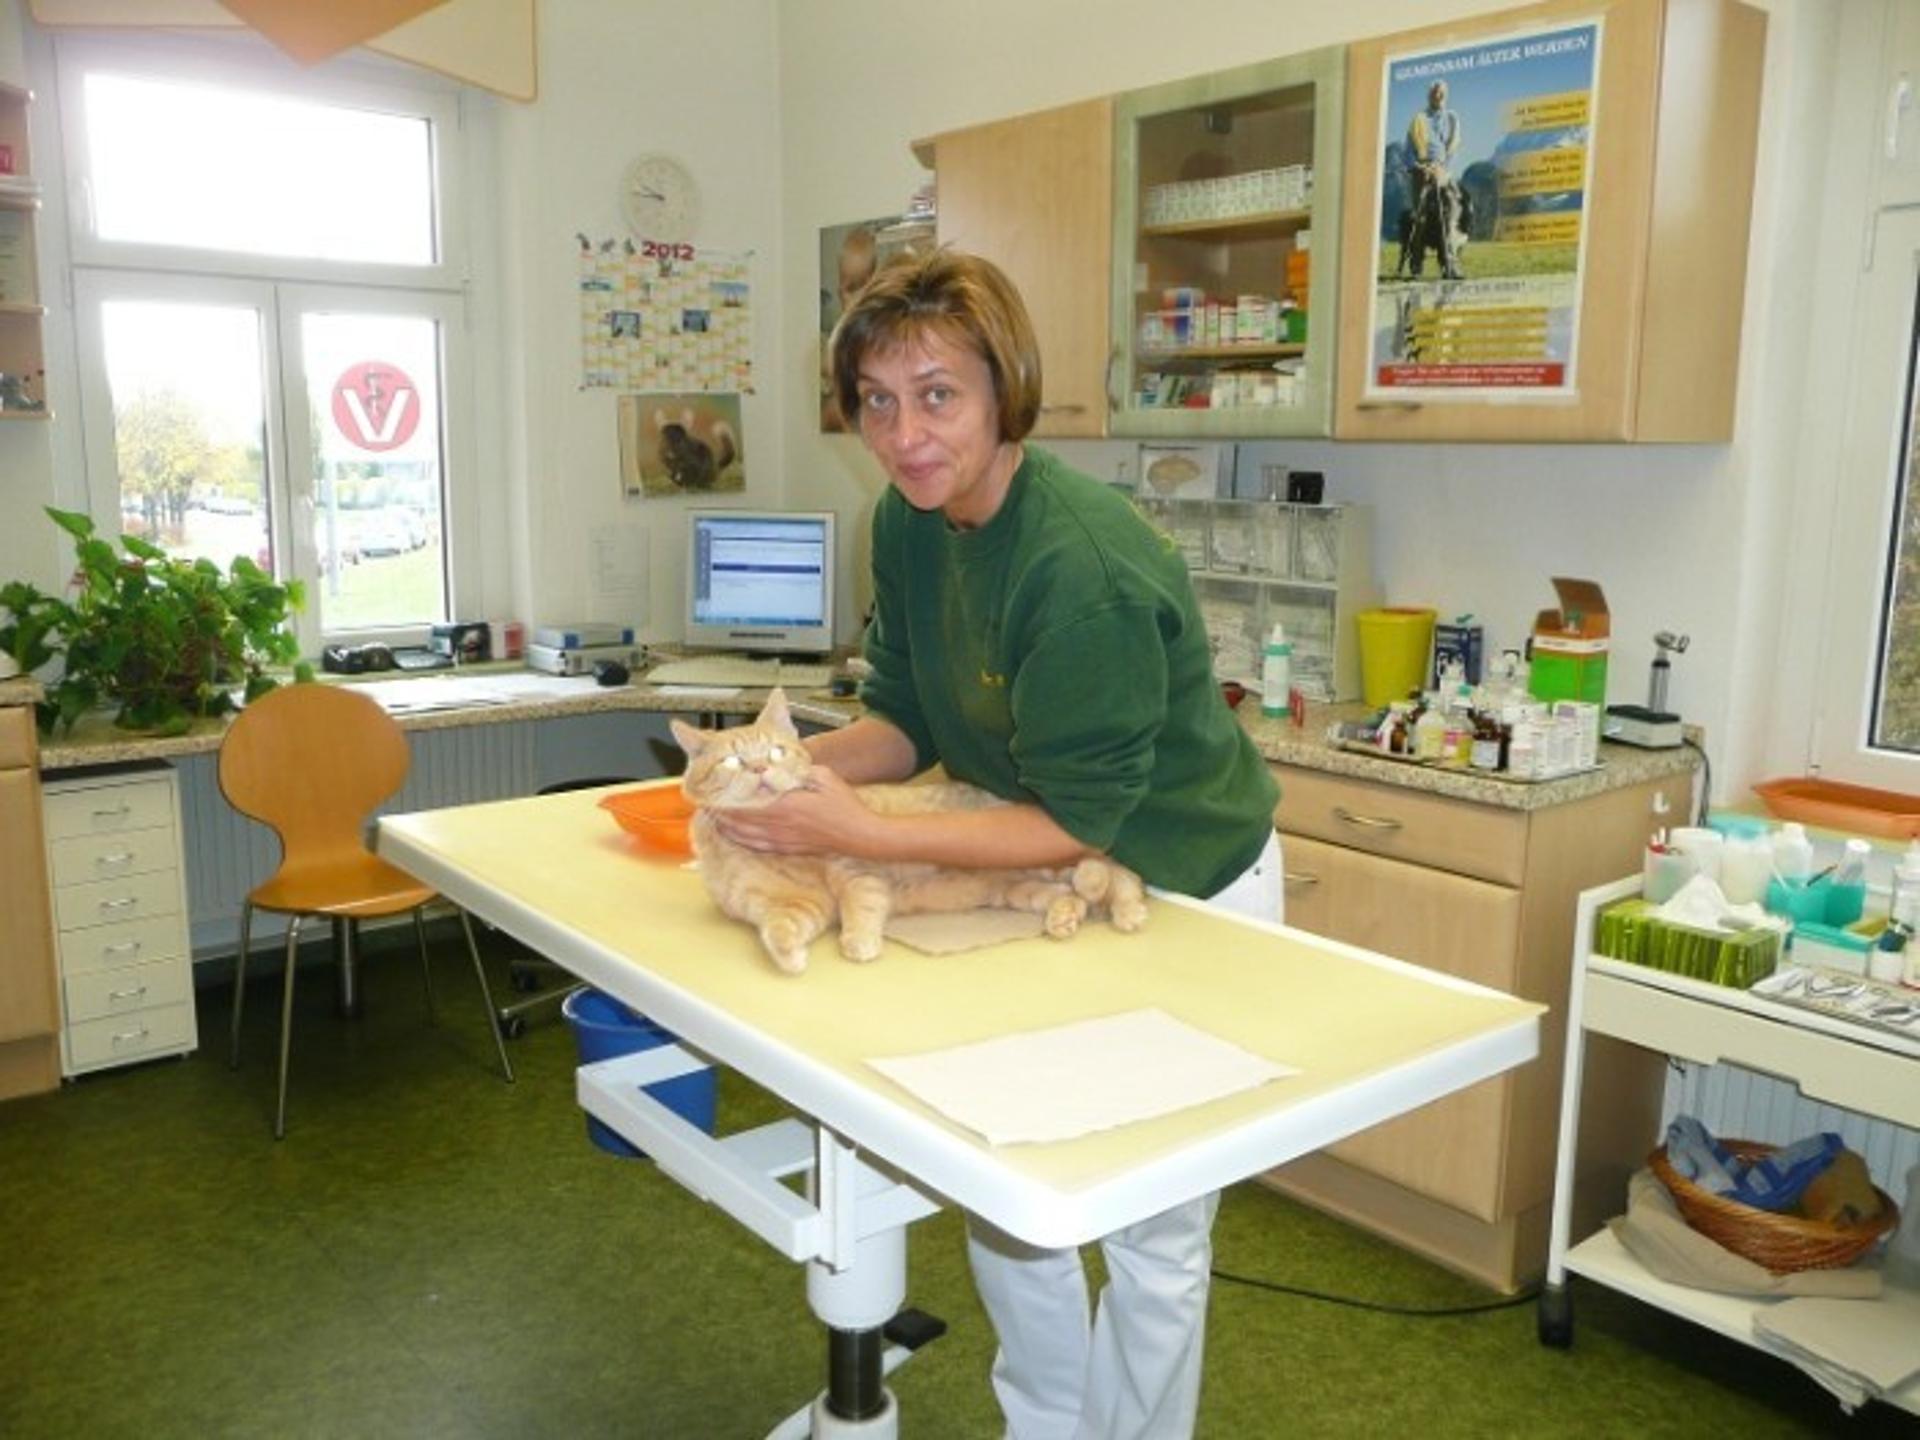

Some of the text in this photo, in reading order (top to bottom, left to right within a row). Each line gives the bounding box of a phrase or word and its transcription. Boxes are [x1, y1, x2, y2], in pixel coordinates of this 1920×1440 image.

[1524, 34, 1589, 58] WERDEN
[641, 240, 695, 261] 2012
[341, 386, 412, 442] V
